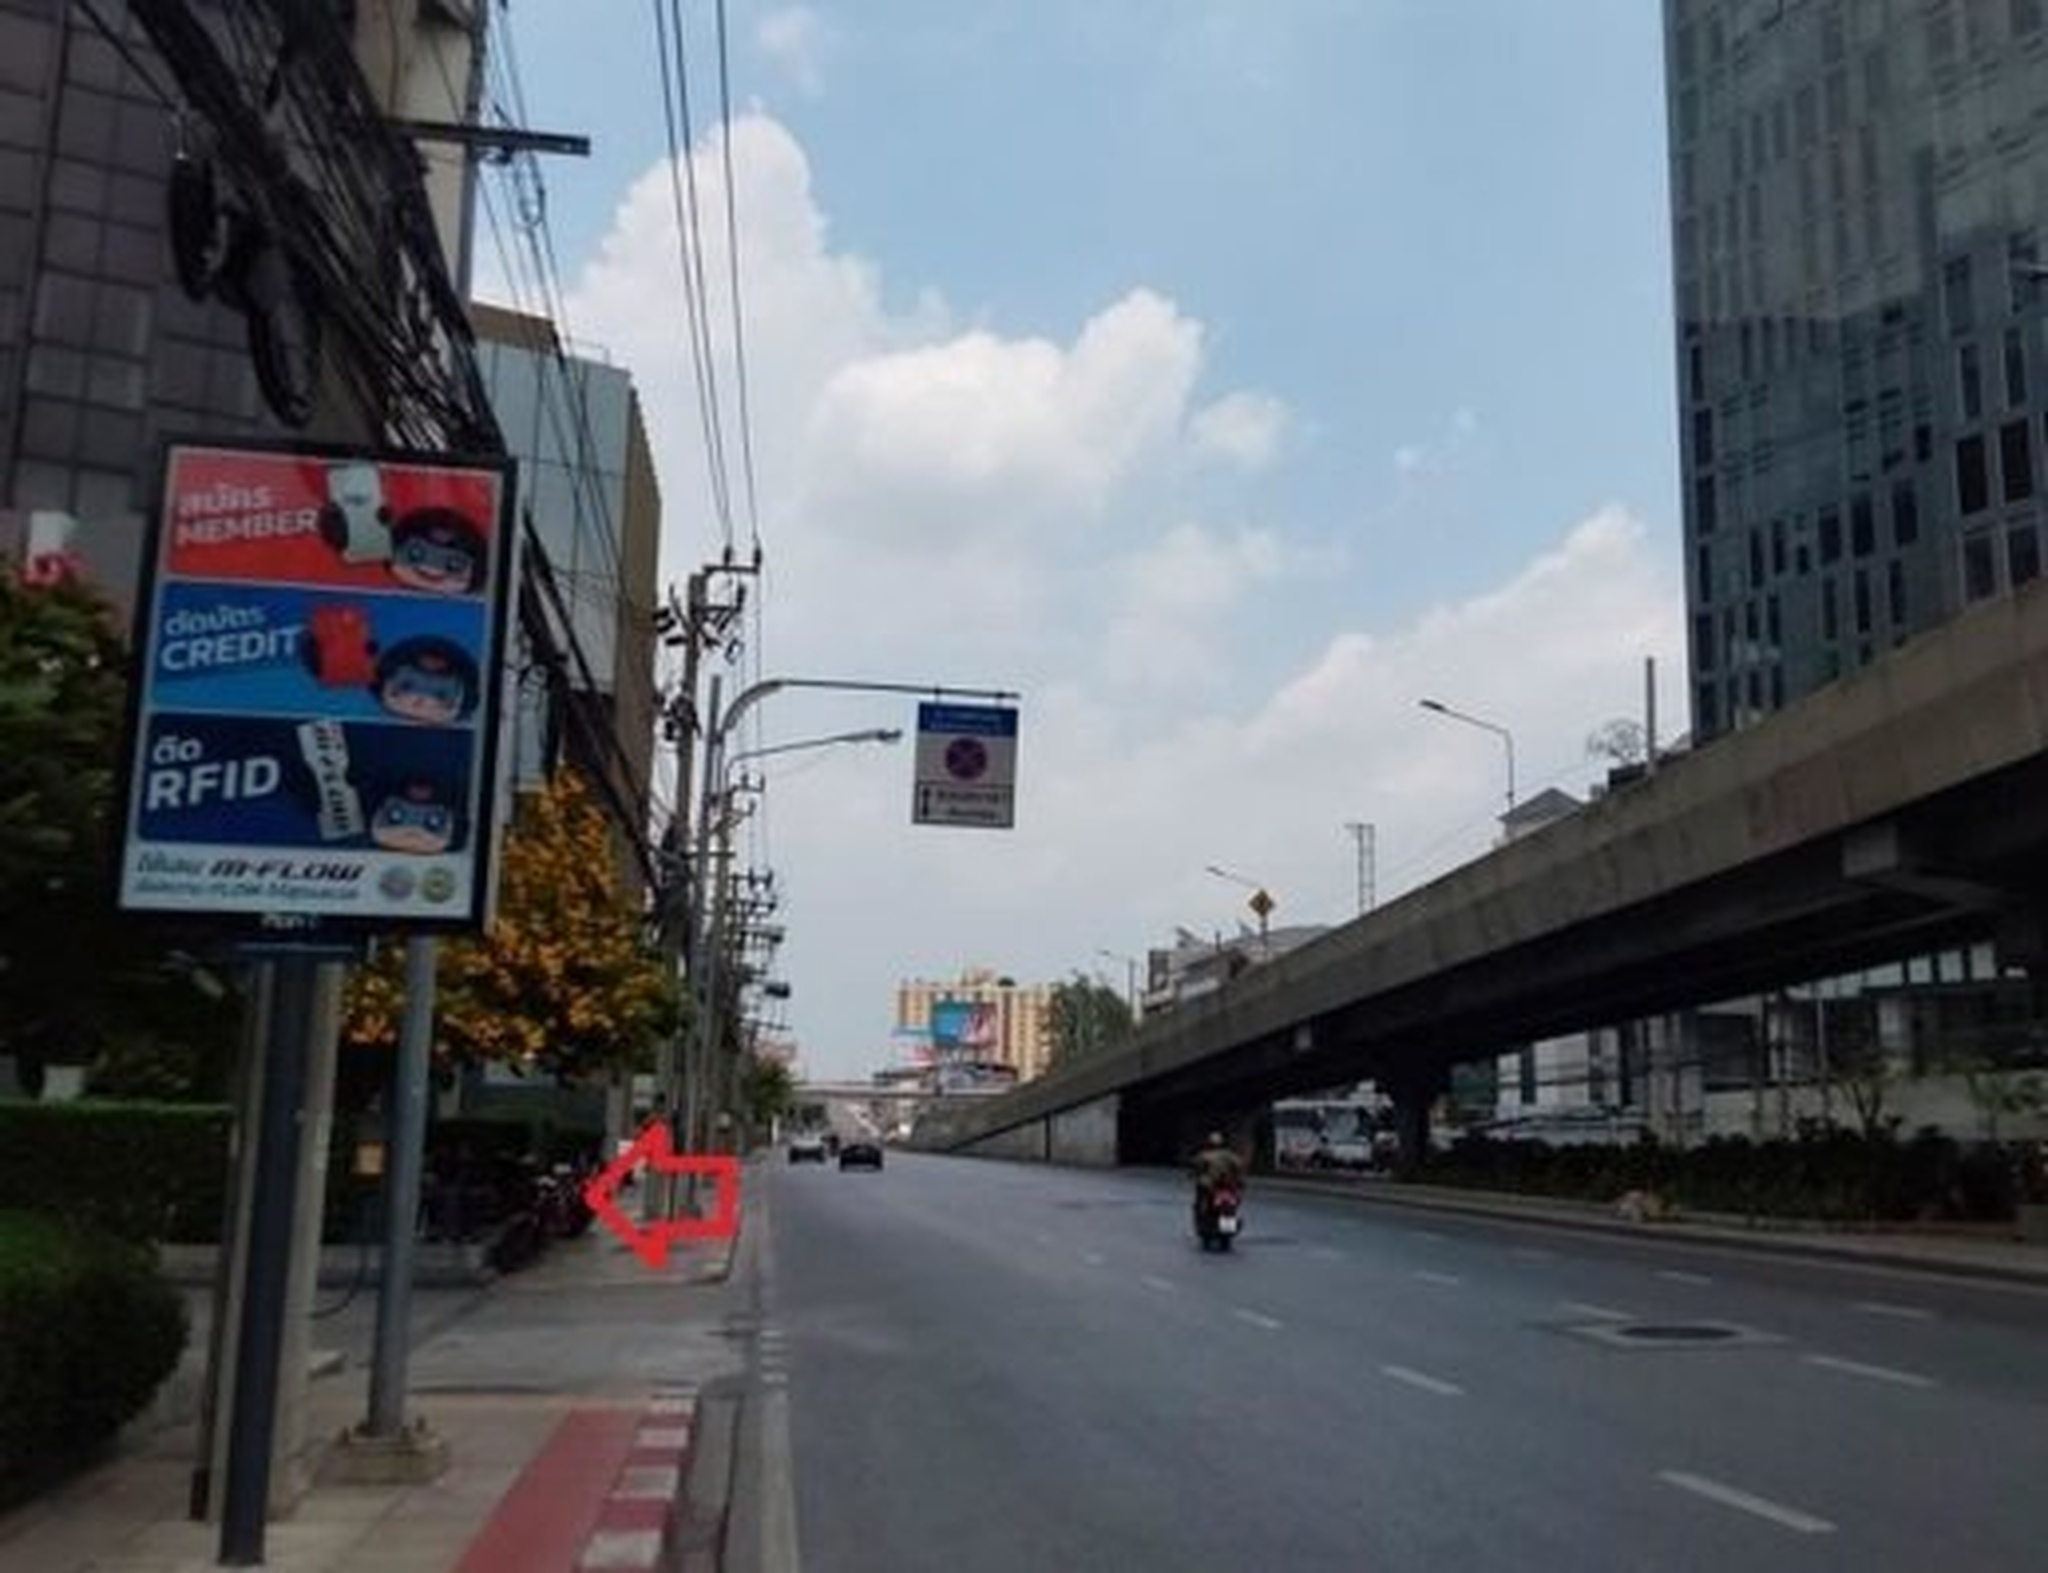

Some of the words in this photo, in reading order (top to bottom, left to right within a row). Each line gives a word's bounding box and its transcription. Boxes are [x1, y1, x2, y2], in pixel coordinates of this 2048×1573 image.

[176, 508, 318, 547] MEMBER
[161, 625, 304, 671] CREDIT
[147, 756, 281, 810] RFID
